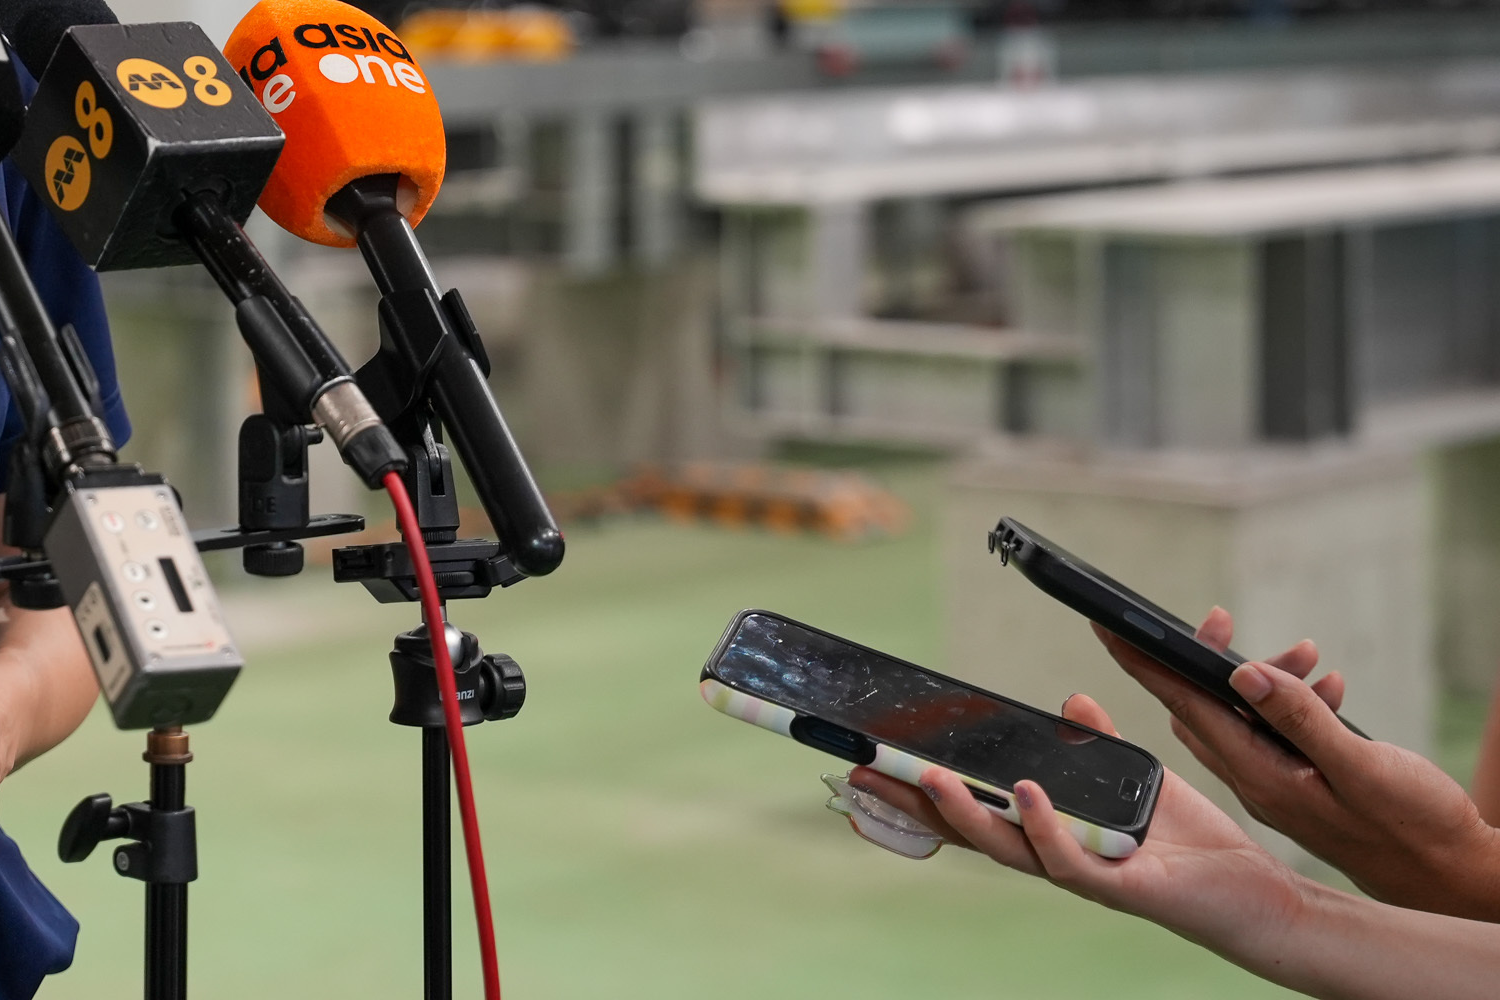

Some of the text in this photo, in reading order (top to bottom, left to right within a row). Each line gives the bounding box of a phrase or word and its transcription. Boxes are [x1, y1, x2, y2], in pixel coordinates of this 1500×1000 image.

[293, 23, 414, 65] asia
[183, 55, 232, 106] 8
[319, 53, 426, 94] one
[75, 80, 113, 159] 8
